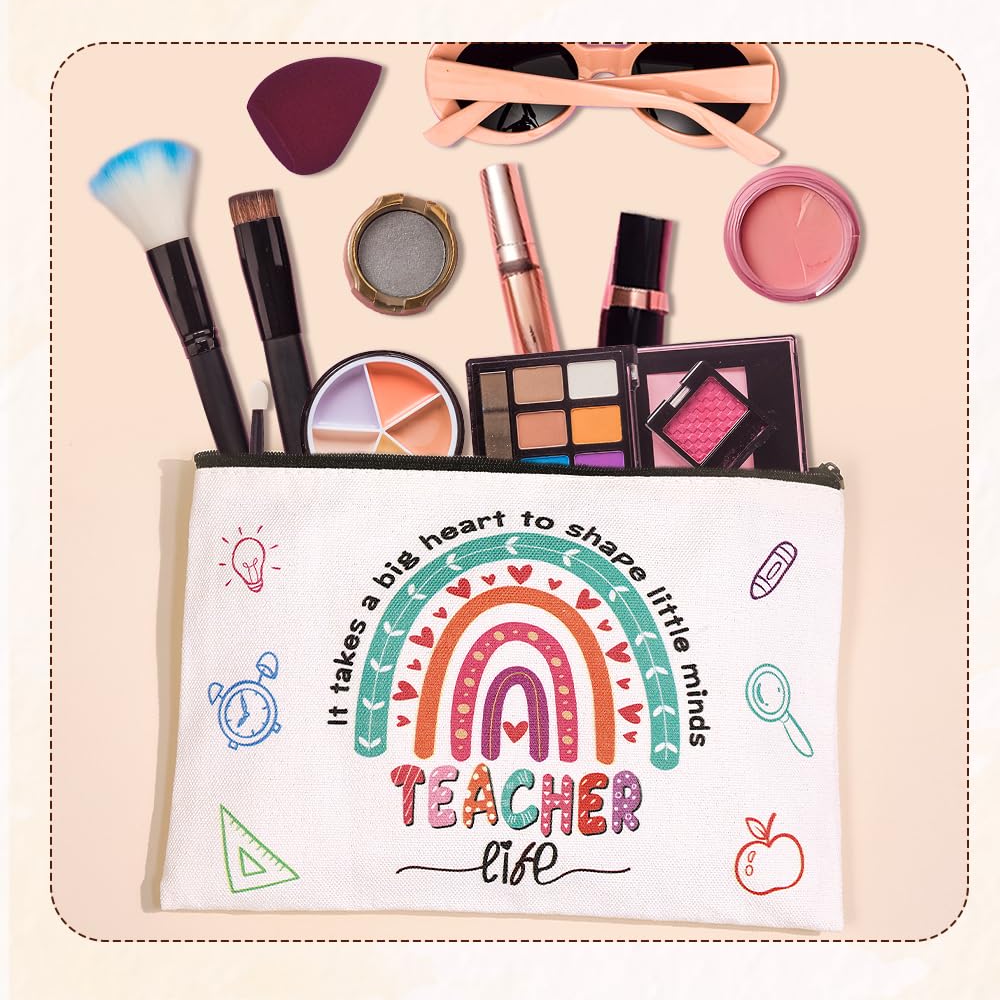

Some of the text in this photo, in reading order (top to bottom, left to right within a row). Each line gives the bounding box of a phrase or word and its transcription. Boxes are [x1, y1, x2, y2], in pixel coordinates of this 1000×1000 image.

[327, 510, 711, 747] It takes a big heart to shape little minds
[390, 763, 642, 837] TEACHER
